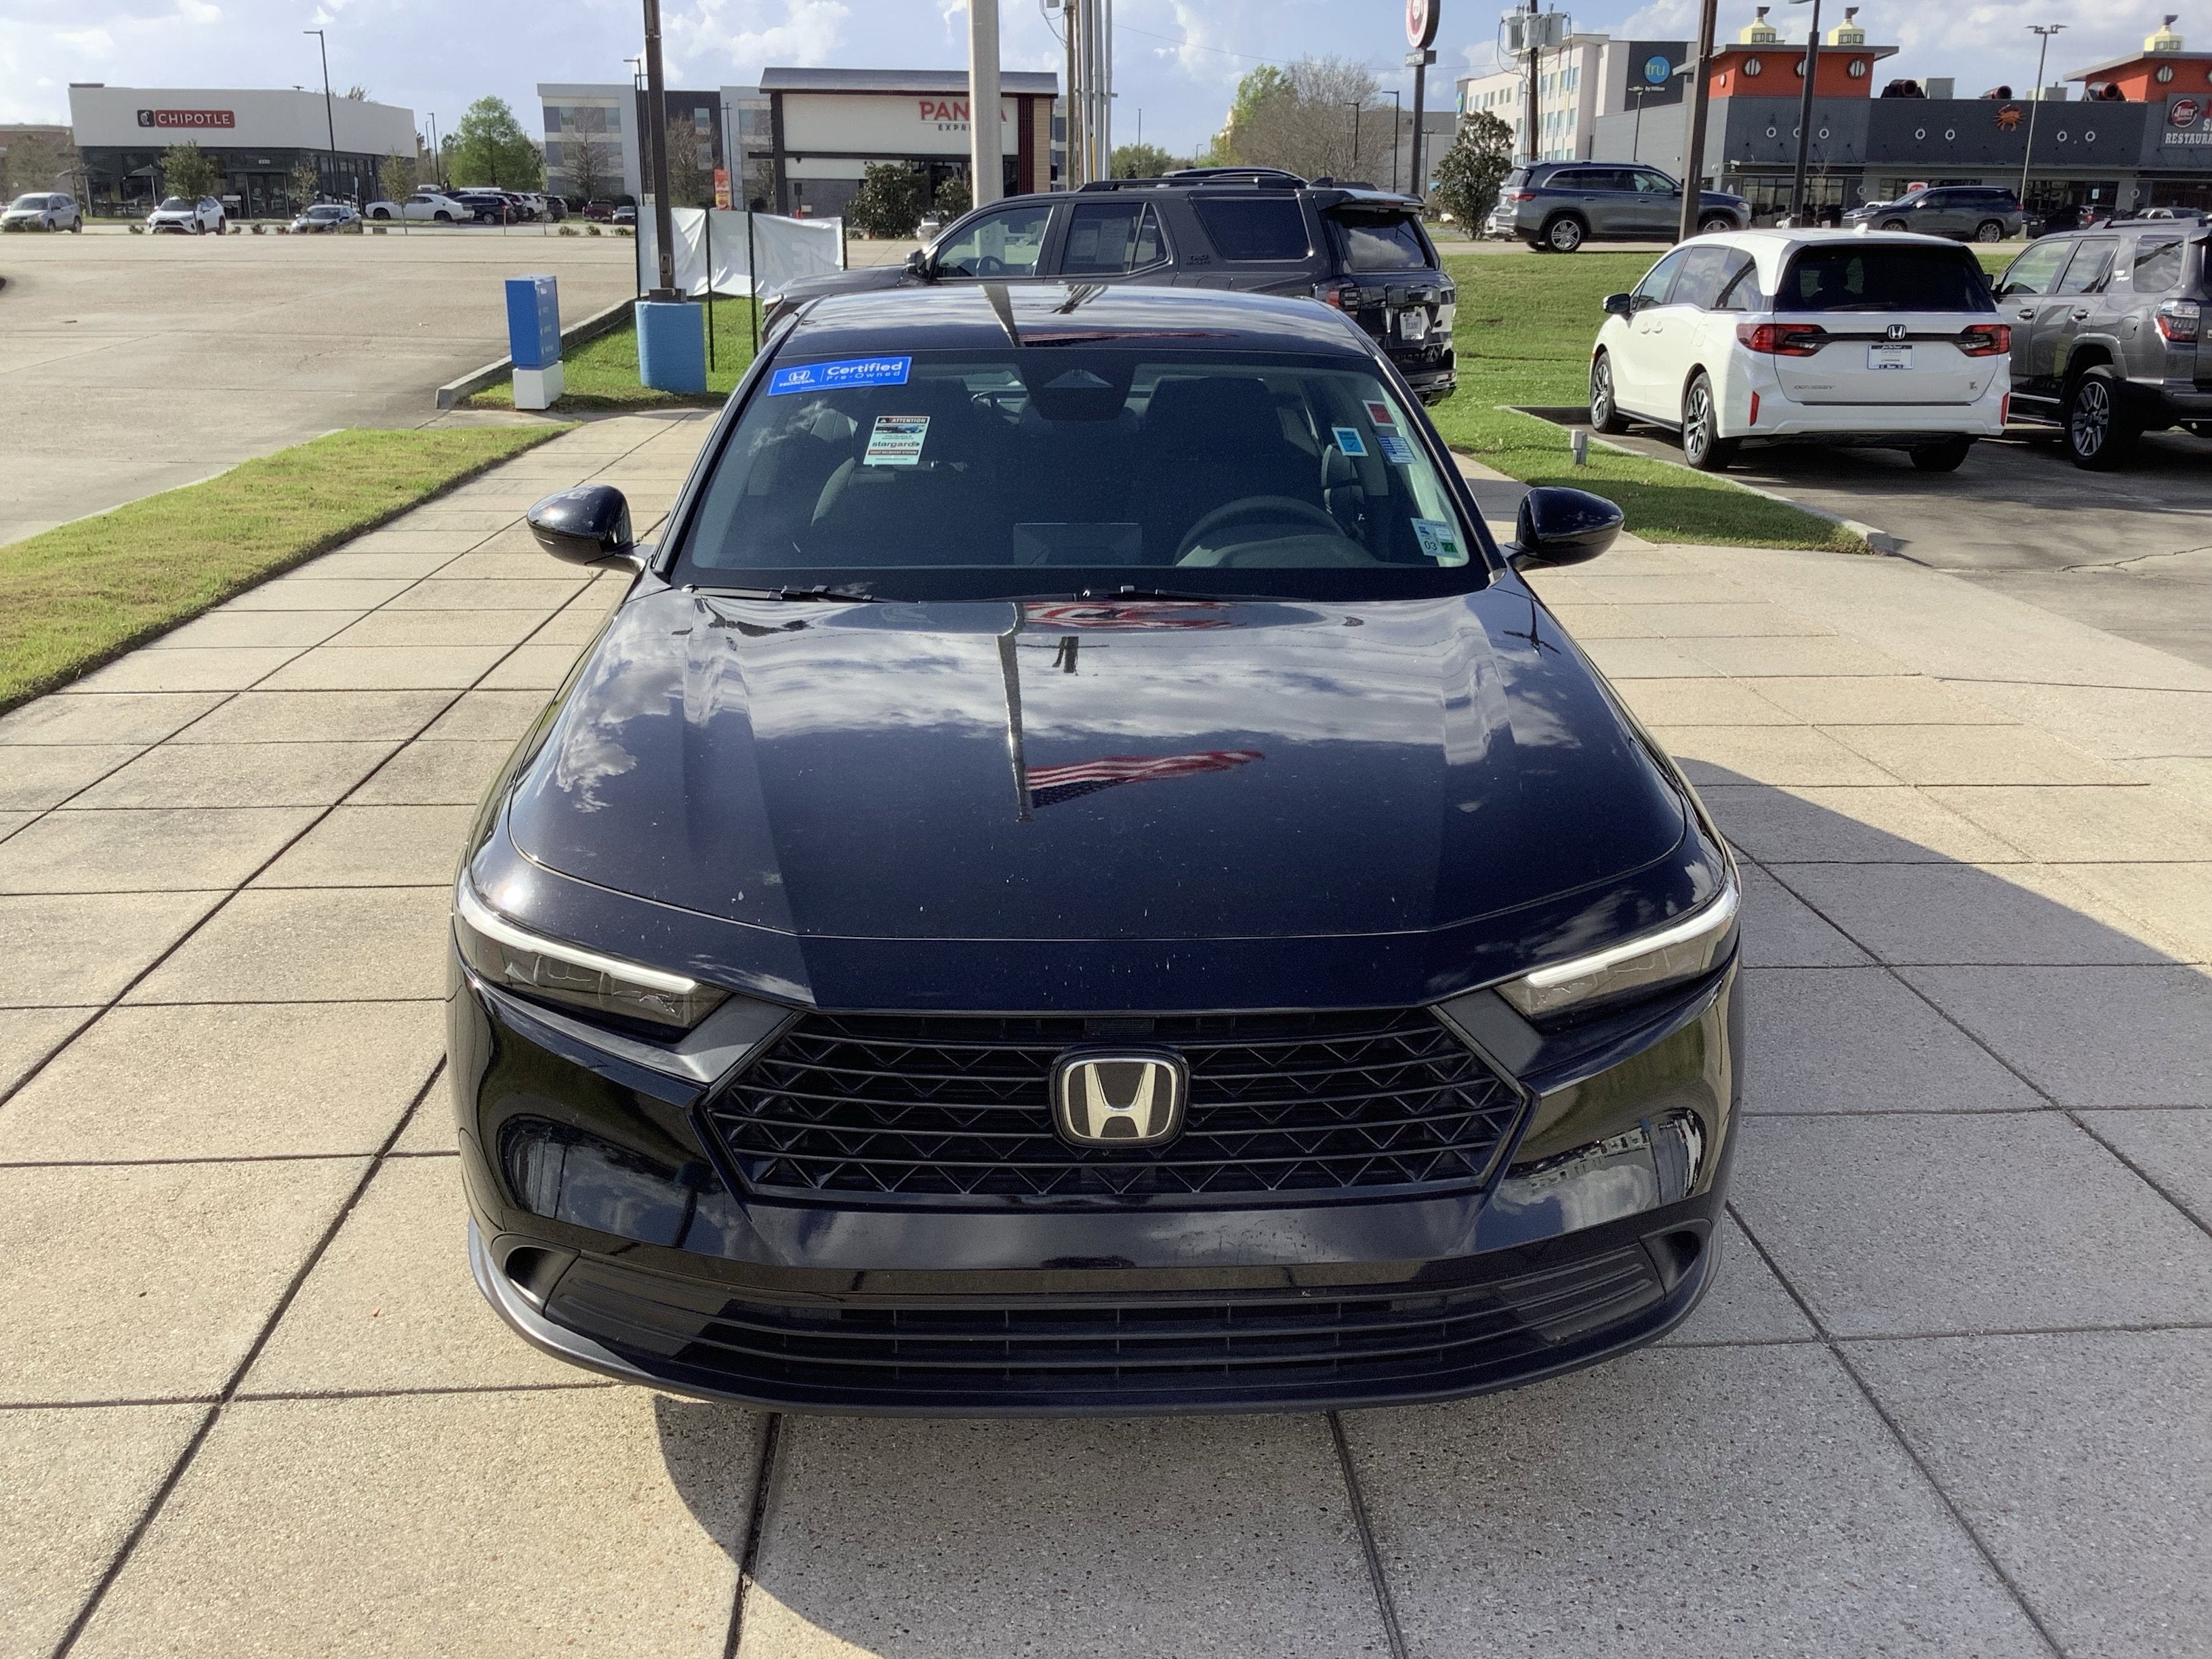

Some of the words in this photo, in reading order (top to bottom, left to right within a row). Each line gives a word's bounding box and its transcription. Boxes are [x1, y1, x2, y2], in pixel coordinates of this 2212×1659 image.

[1647, 62, 1666, 76] tru
[158, 113, 230, 124] CHIPOTLE
[827, 361, 903, 375] Certified
[826, 371, 901, 382] Pre-Owned
[779, 379, 816, 387] HONDA
[1424, 541, 1437, 550] 03
